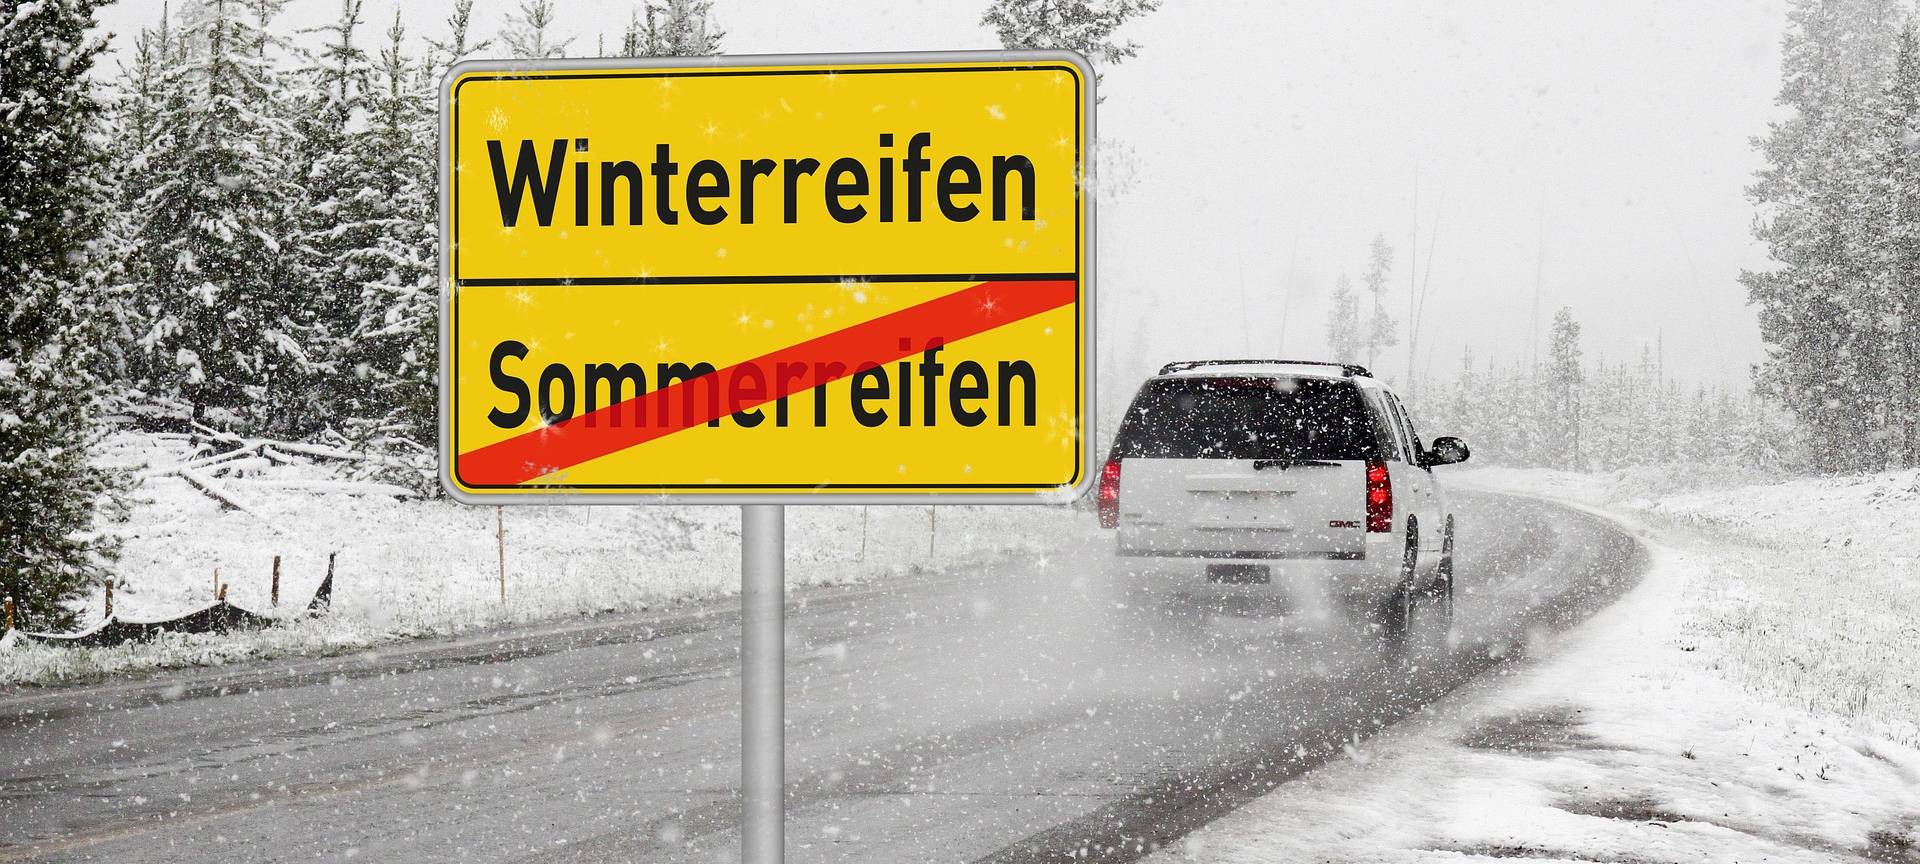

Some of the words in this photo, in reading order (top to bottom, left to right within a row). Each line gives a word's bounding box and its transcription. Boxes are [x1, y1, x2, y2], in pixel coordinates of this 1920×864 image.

[487, 132, 1036, 227] Winterreifen
[487, 337, 1036, 428] Sommerreifen
[1329, 520, 1361, 528] GMC
